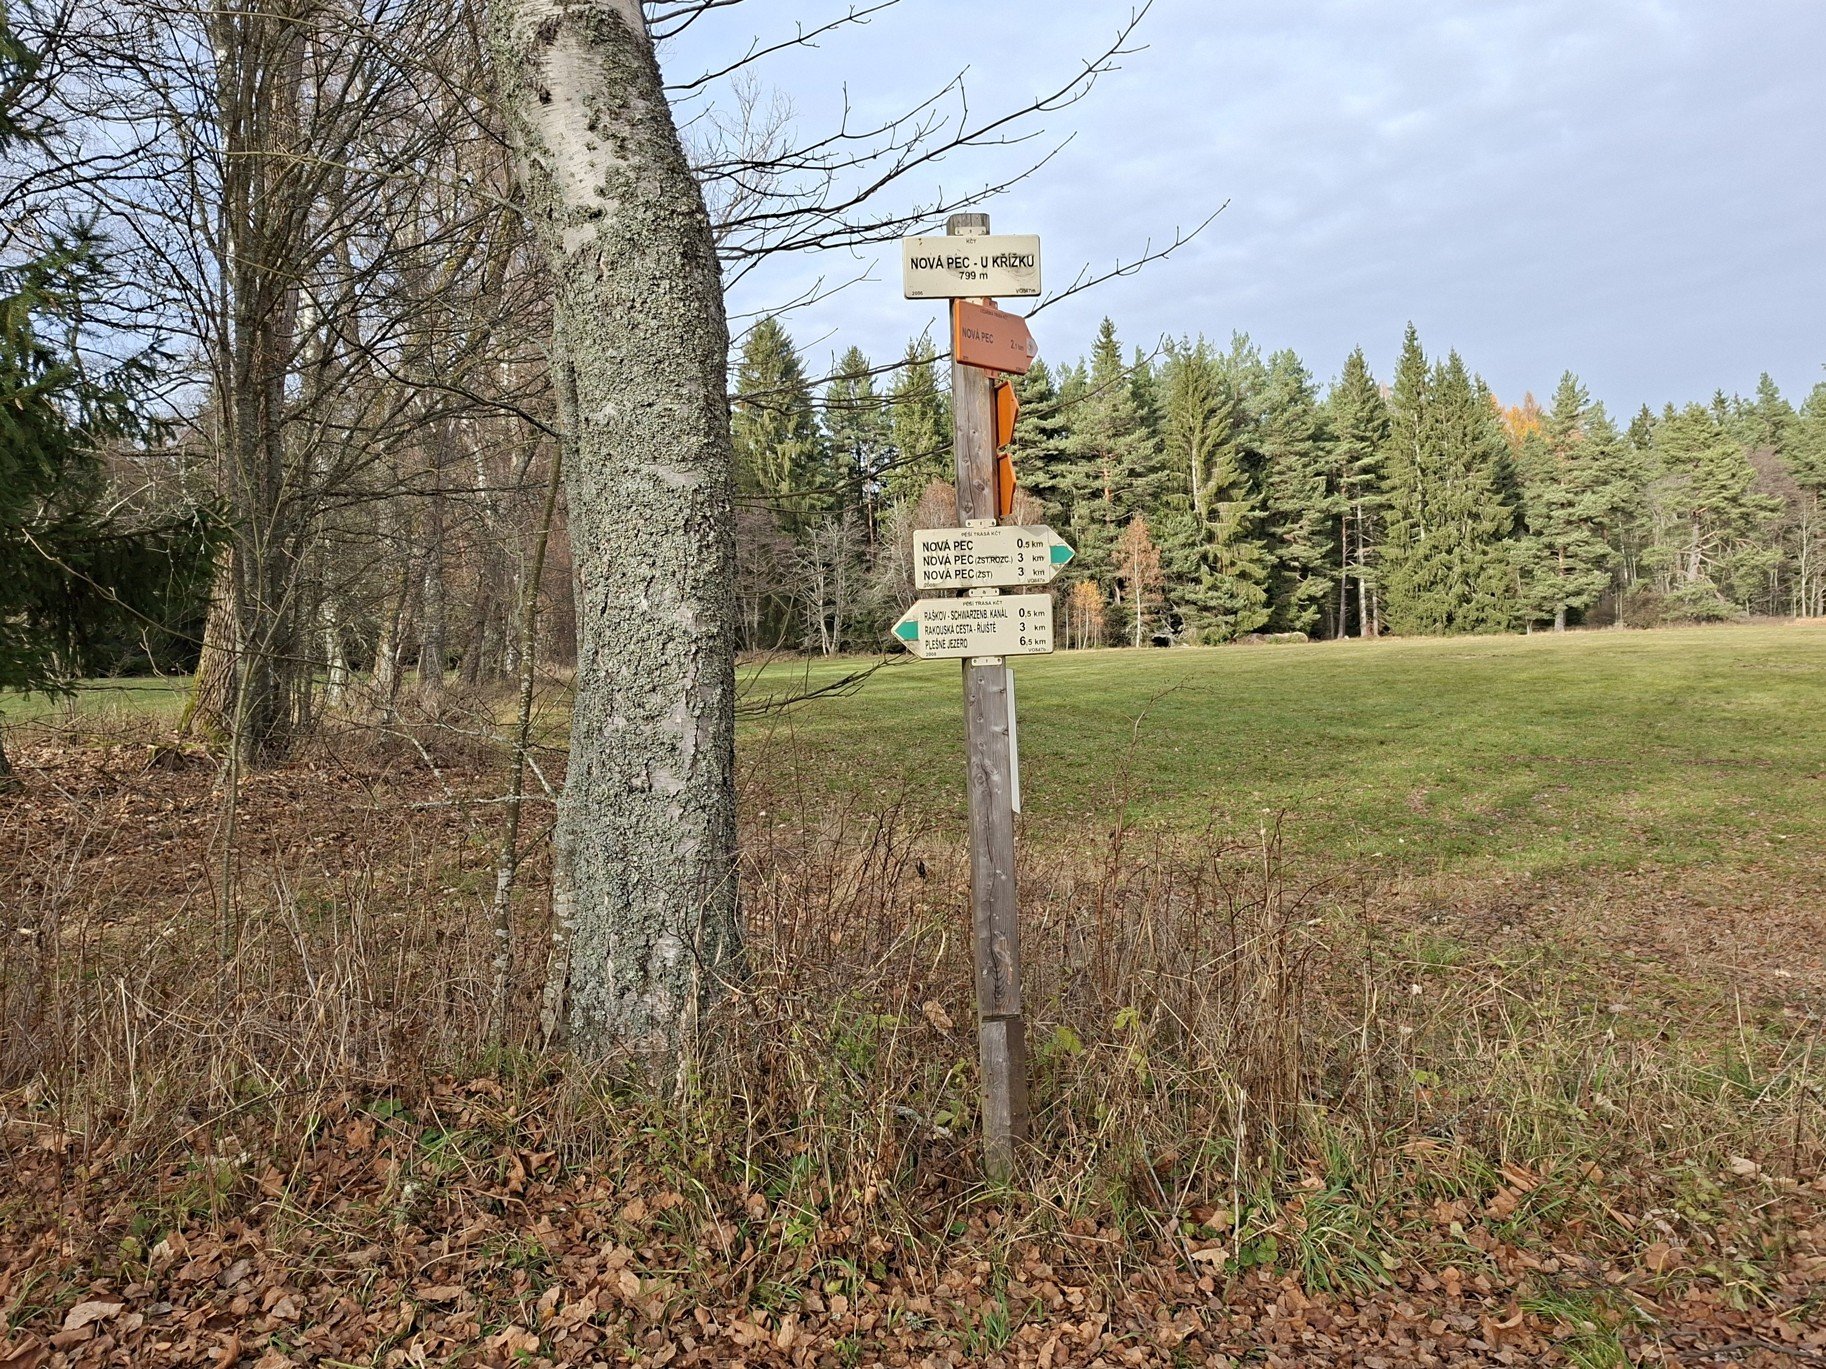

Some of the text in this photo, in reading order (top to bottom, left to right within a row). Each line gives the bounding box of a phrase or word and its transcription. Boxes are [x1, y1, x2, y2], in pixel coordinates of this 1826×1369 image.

[911, 255, 944, 269] NOVÁ
[947, 257, 970, 269] PEC
[981, 257, 988, 268] U
[992, 253, 1035, 268] KŘÍŽKU
[962, 327, 980, 340] NOVÁ
[981, 332, 994, 344] PEC
[922, 539, 951, 552] NOVÁ
[953, 540, 974, 551] PEC
[923, 553, 952, 566] NOVÁ
[954, 554, 974, 565] PEC
[1017, 552, 1024, 562] 3
[923, 568, 952, 580] NOVÁ
[954, 569, 975, 579] PEC
[1018, 567, 1024, 576] 3
[924, 609, 947, 621] RAŠKOV
[990, 607, 1008, 618] KANÁL
[924, 623, 955, 635] RAKOUSKÁ
[955, 624, 973, 634] CESTA
[1019, 622, 1026, 631] 3
[925, 637, 946, 650] PLEŠNÉ
[947, 638, 968, 649] JEZERO
